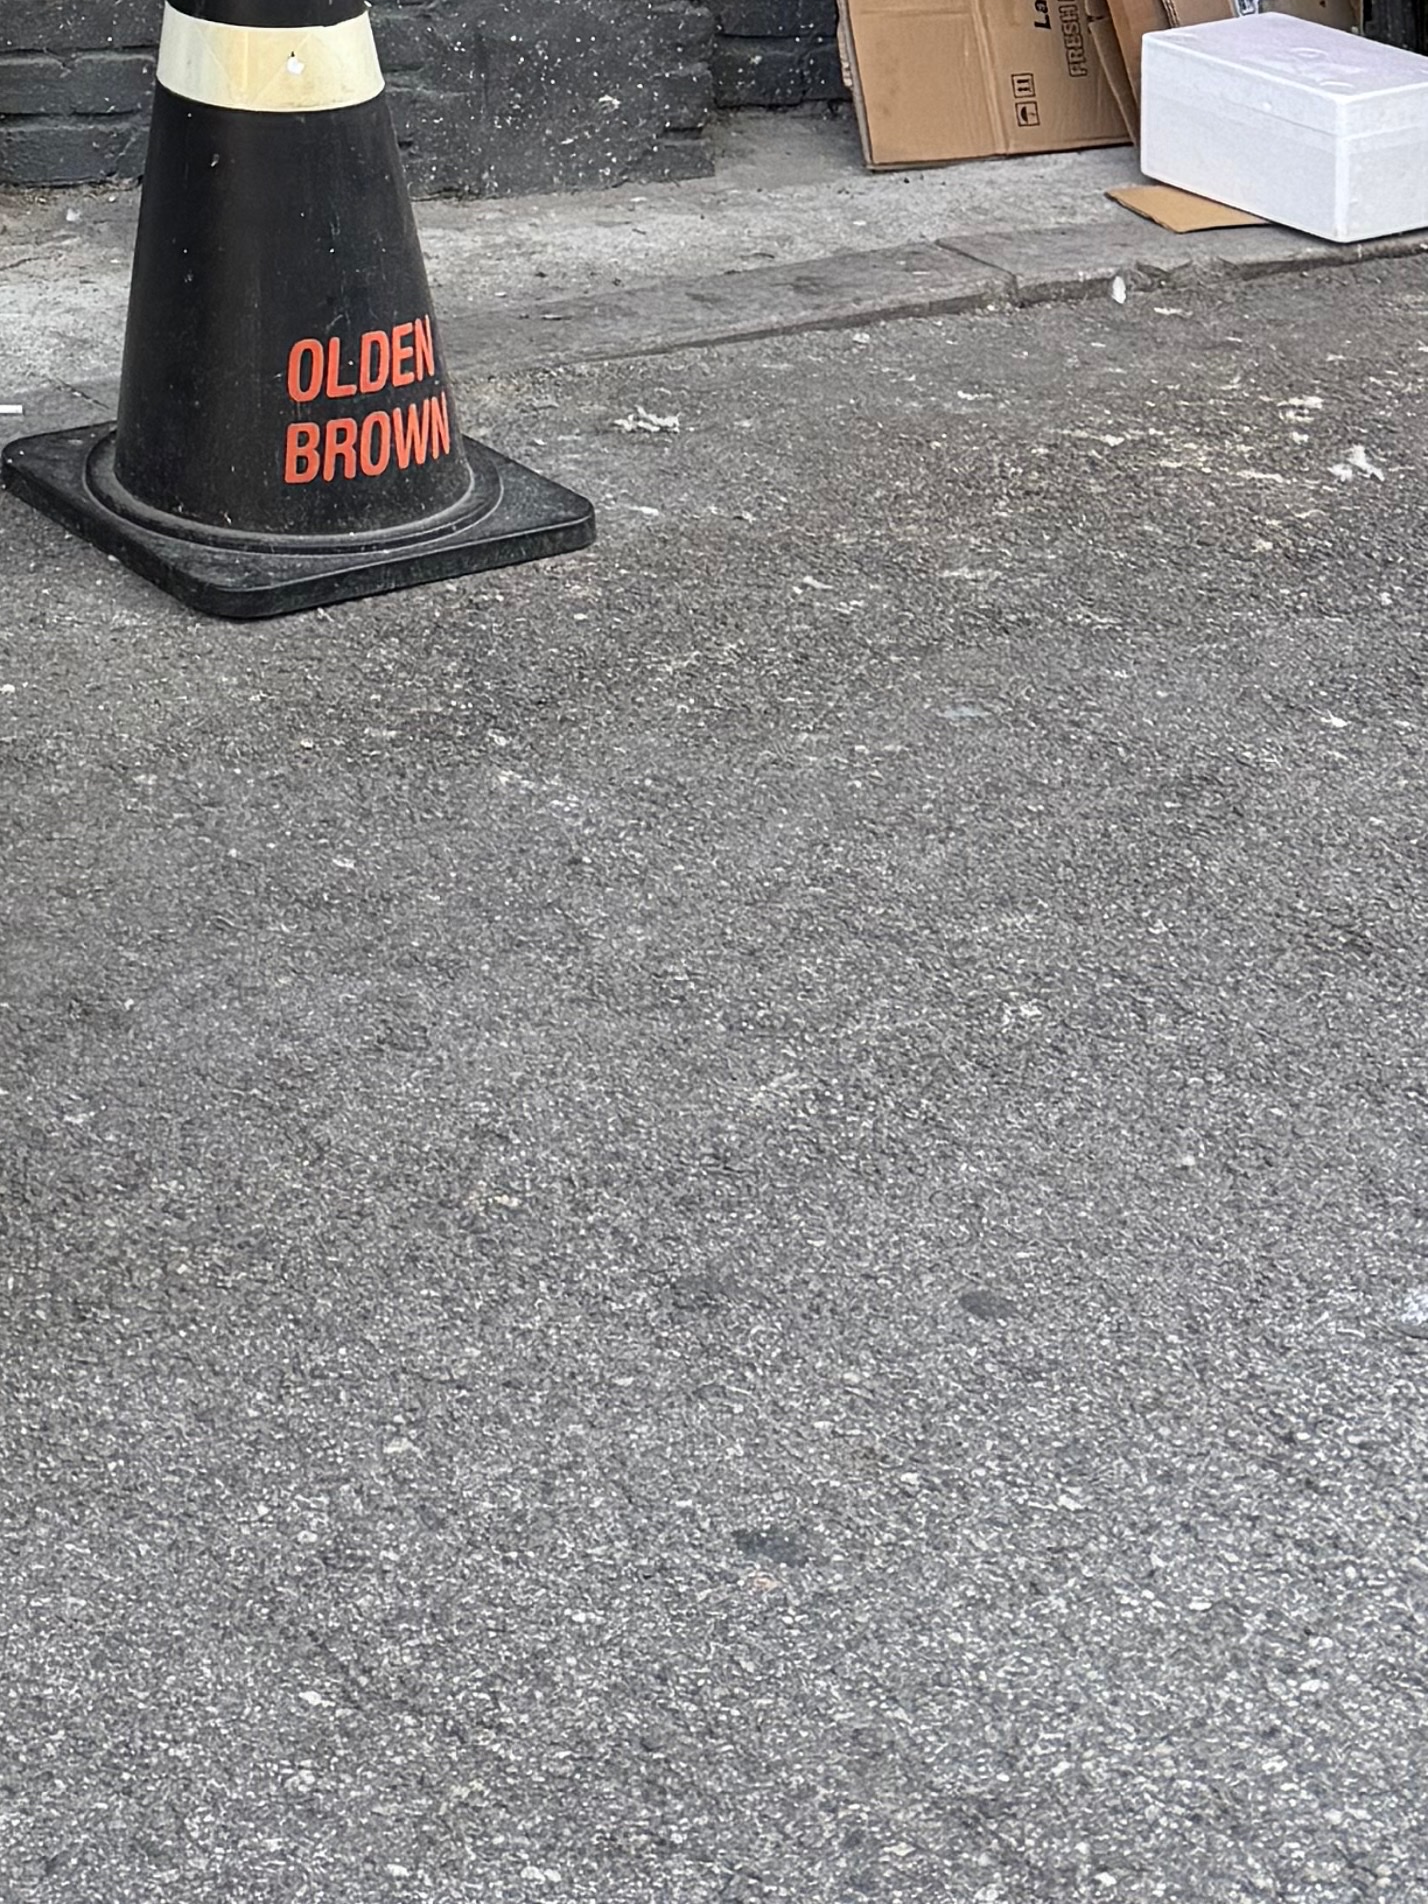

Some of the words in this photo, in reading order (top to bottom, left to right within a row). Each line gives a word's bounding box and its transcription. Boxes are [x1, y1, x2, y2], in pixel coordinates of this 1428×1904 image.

[1058, 4, 1088, 78] FRESH
[287, 313, 435, 403] OLDEN
[283, 390, 450, 484] BROWN
